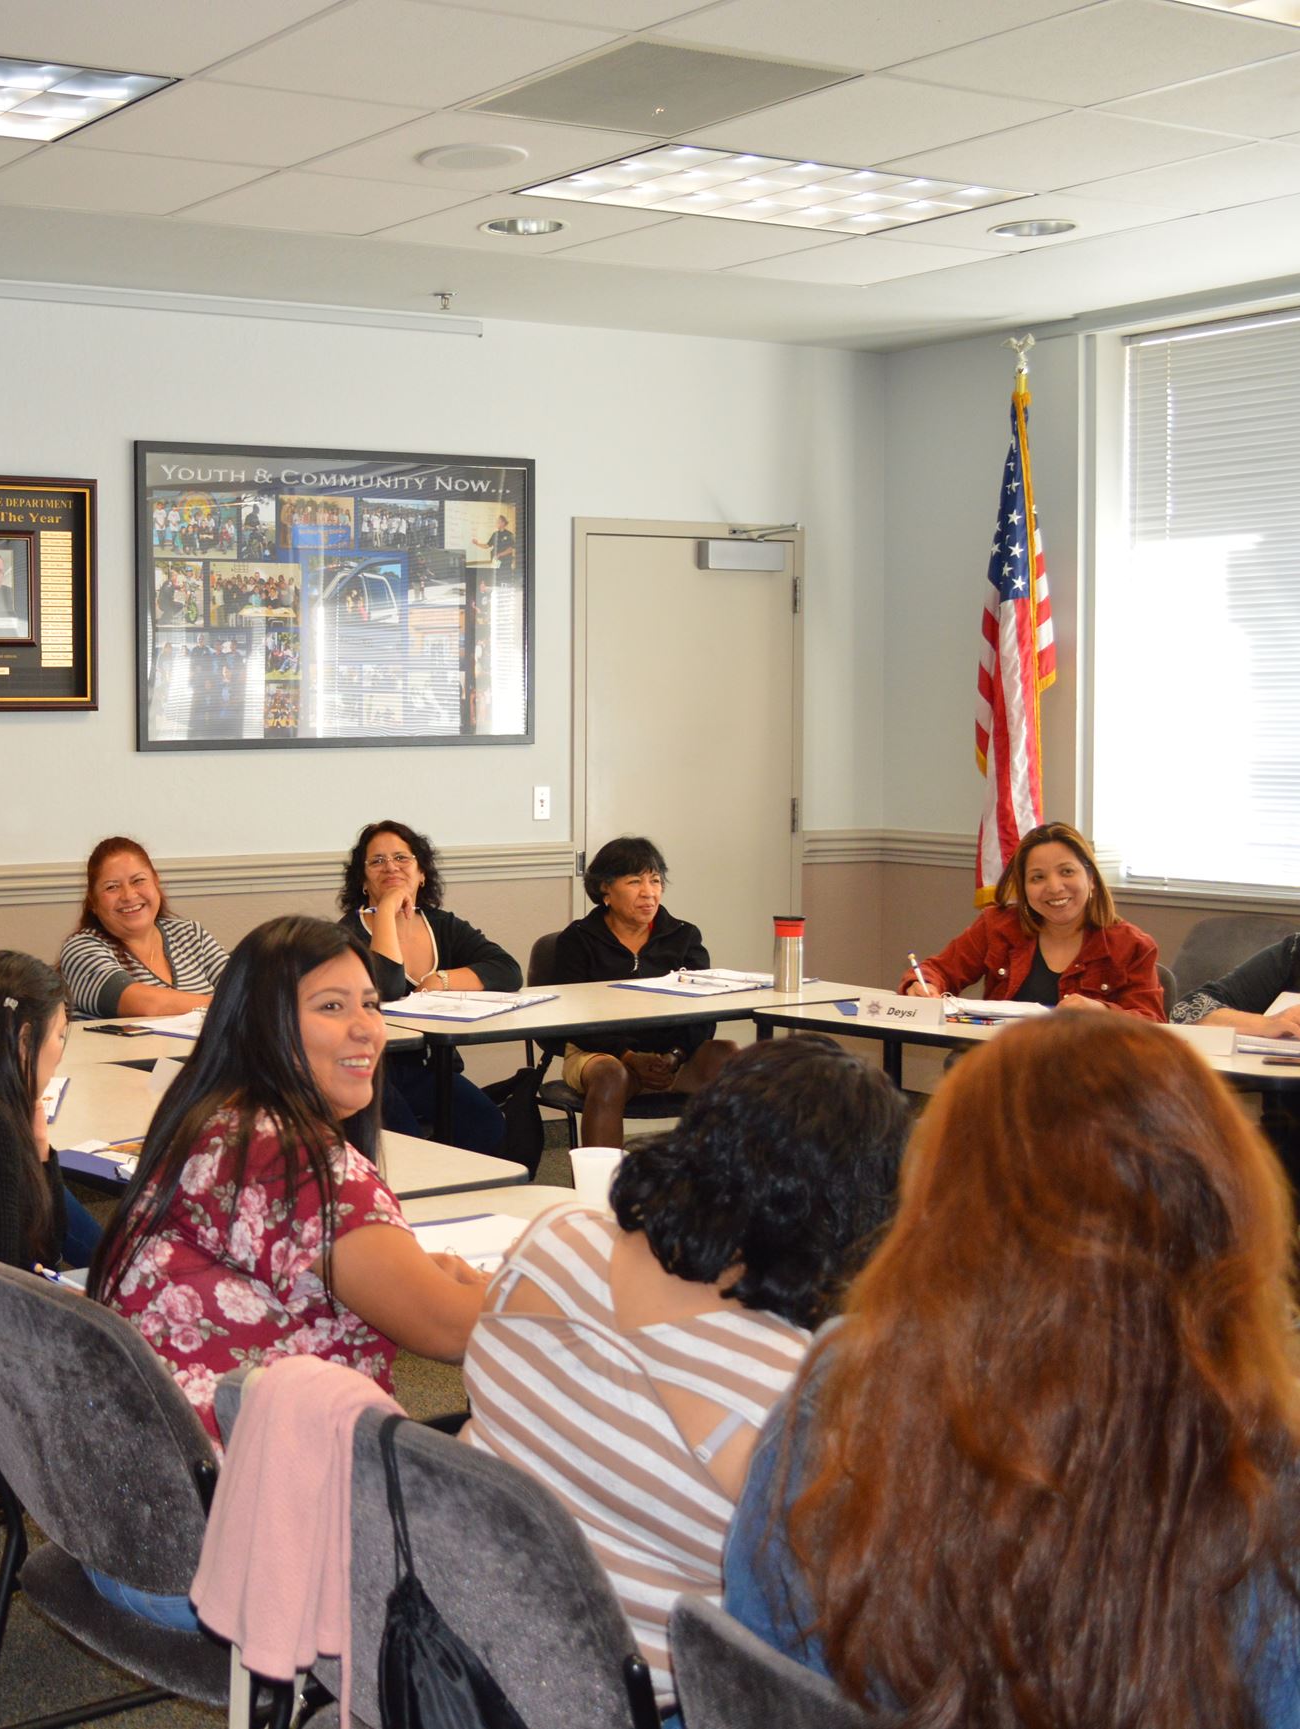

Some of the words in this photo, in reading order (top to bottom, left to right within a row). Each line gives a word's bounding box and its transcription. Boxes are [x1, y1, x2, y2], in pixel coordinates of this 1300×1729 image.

[254, 468, 273, 484] &
[5, 498, 73, 510] DEPARTMENT
[29, 512, 62, 524] Year
[886, 1007, 918, 1018] Deysi
